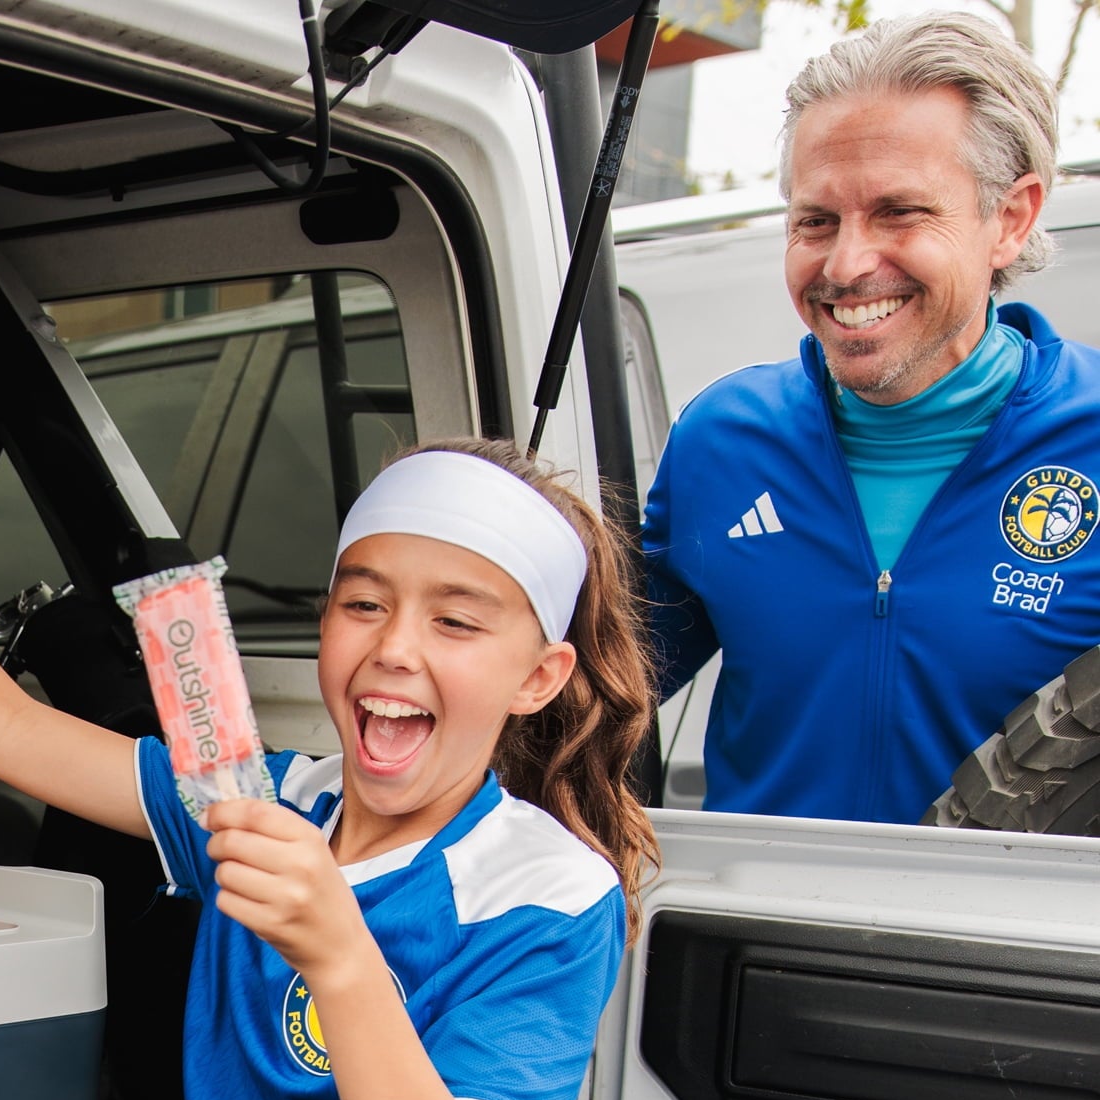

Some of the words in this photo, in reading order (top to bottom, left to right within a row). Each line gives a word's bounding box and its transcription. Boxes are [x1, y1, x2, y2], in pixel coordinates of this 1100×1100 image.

[1026, 470, 1093, 499] GUNDO
[1005, 515, 1054, 558] FOOTBALL
[1056, 529, 1088, 556] CLUB
[992, 562, 1065, 595] Coach
[992, 583, 1052, 615] Brad
[167, 618, 220, 762] Outshine
[288, 1010, 331, 1071] FOOTBAL
